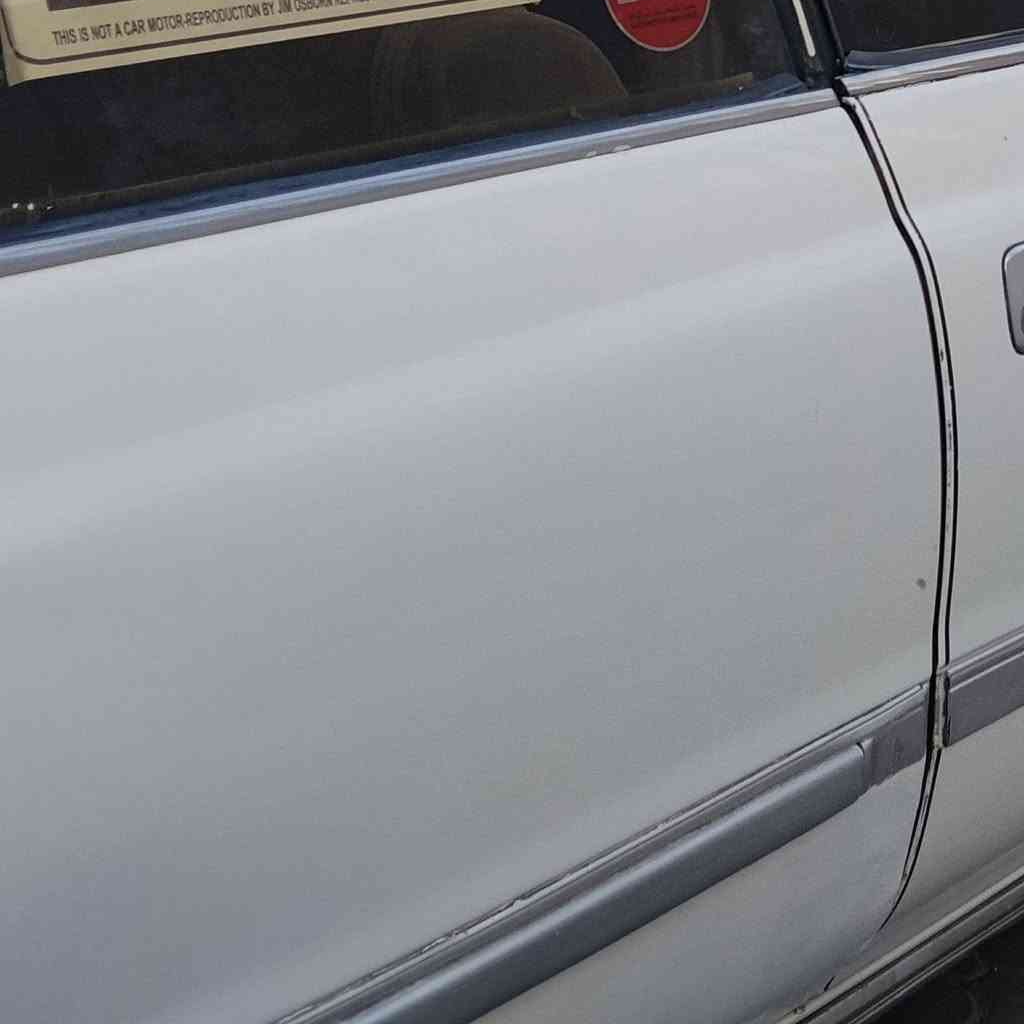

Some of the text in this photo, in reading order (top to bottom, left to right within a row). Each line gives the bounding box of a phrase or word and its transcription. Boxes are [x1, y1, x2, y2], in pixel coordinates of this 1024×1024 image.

[52, 28, 81, 46] THIS
[79, 29, 91, 44] IS
[90, 23, 116, 42] NOT
[115, 22, 125, 37] A
[124, 17, 147, 36] CAR
[262, 0, 279, 16] BY
